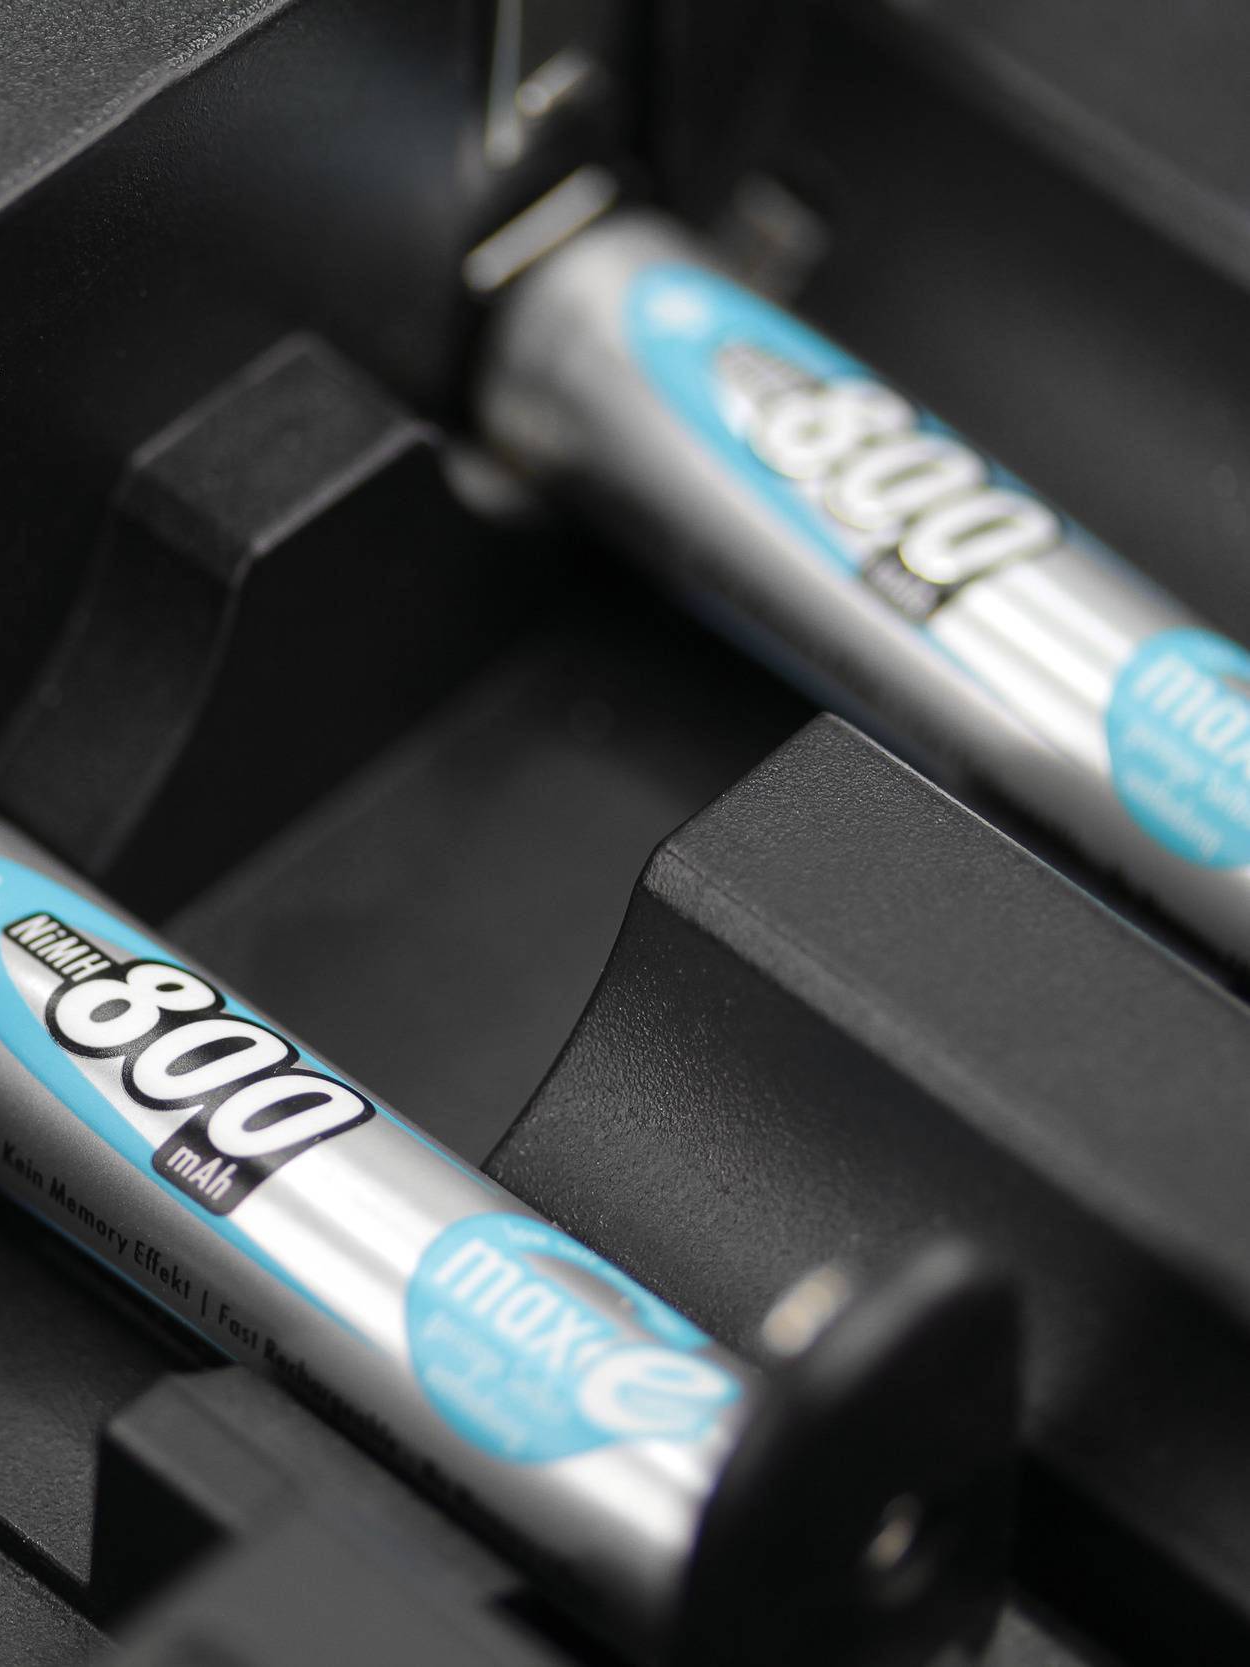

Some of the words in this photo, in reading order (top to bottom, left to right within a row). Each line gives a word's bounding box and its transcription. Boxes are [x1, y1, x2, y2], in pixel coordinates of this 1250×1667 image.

[8, 913, 112, 982] NiMH
[52, 960, 368, 1160] 800
[166, 1144, 239, 1201] mAh
[2, 1139, 45, 1190] Kein
[49, 1176, 130, 1256] Memory
[133, 1239, 192, 1300] Effekt
[217, 1302, 259, 1350] Fast
